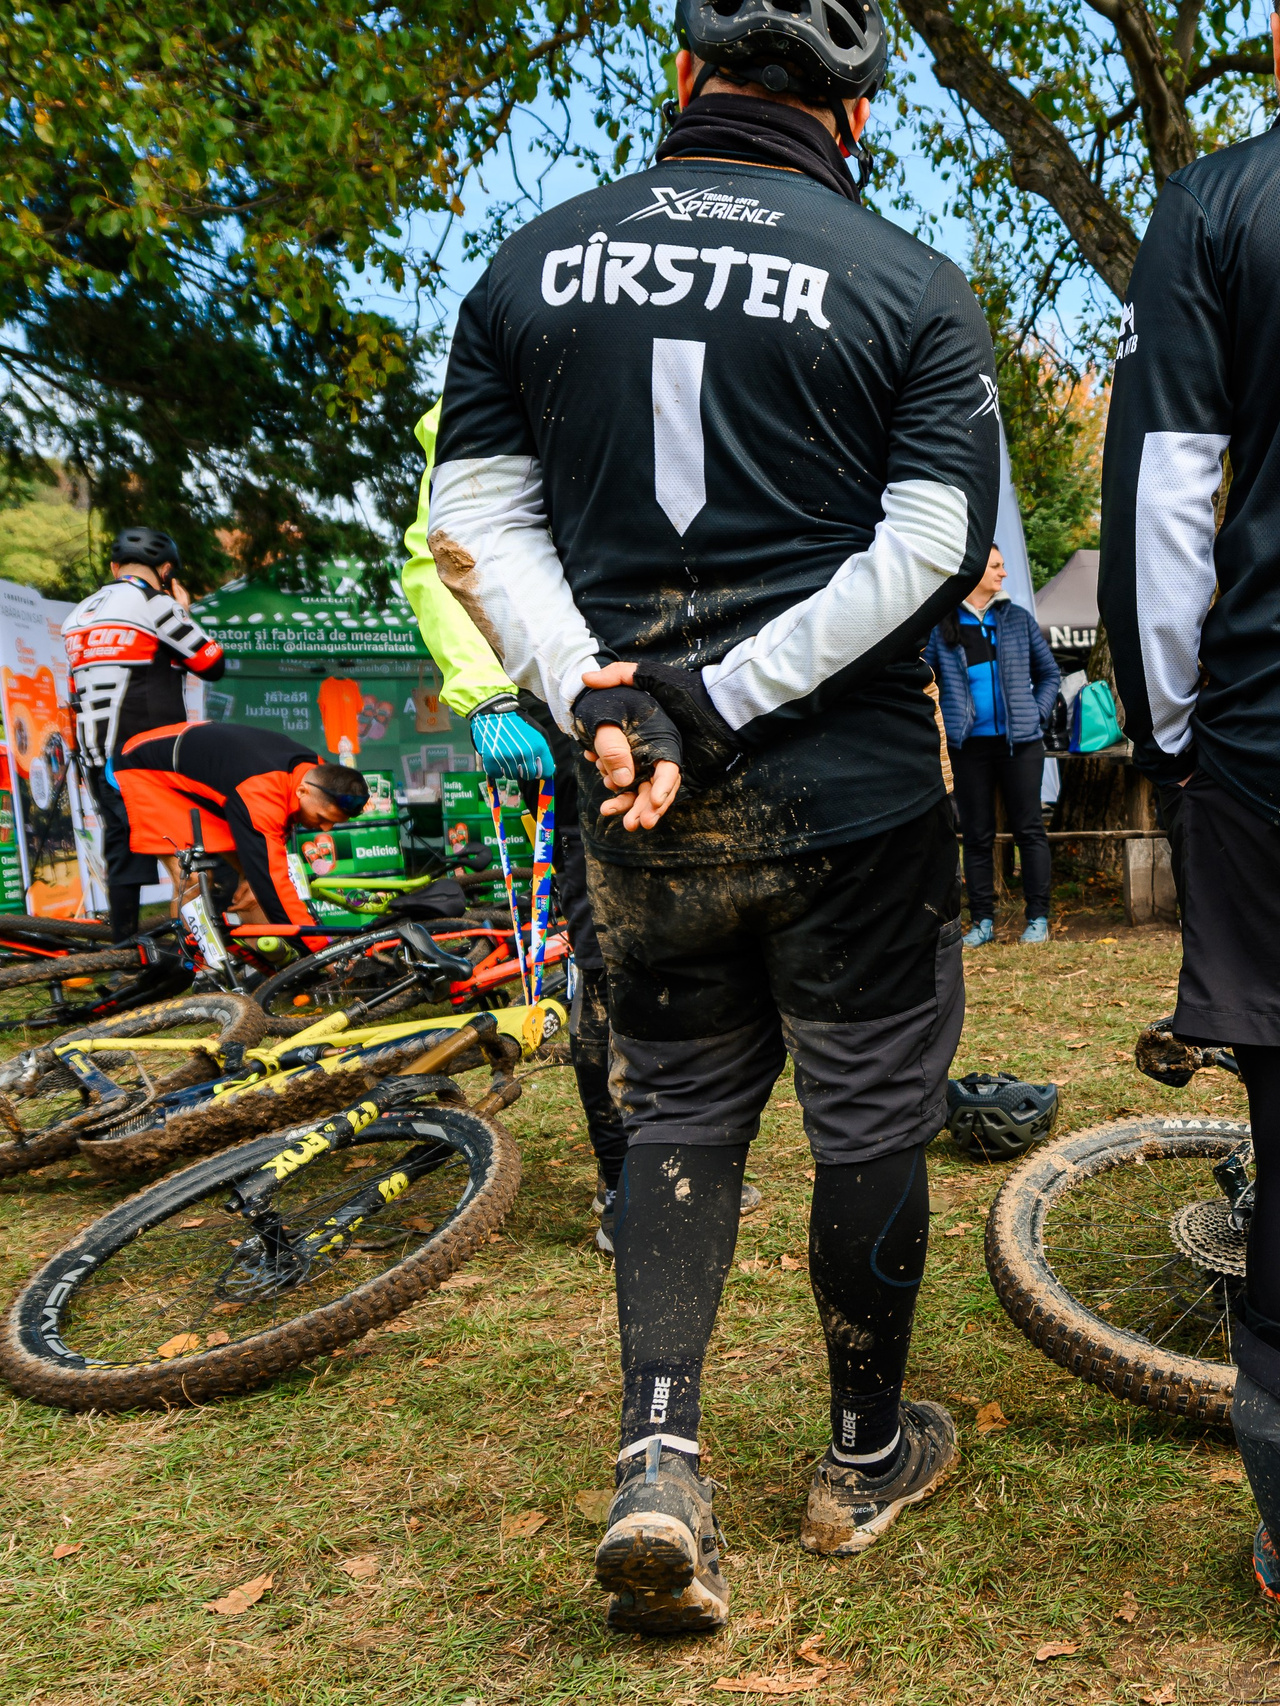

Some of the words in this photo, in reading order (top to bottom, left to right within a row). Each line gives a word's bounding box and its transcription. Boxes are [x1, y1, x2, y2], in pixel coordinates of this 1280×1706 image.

[616, 185, 786, 226] XPERIENCE
[703, 192, 734, 203] TRIADA
[541, 231, 831, 330] CÎRSTEA
[208, 628, 250, 640] bator
[270, 628, 325, 641] fabrică
[329, 629, 347, 641] de
[351, 630, 413, 642] mezeluri
[355, 846, 398, 859] Delicios
[484, 835, 524, 846] Decios
[260, 1131, 331, 1180] FOX
[649, 1376, 671, 1424] CUBE
[841, 1409, 857, 1448] CUBE
